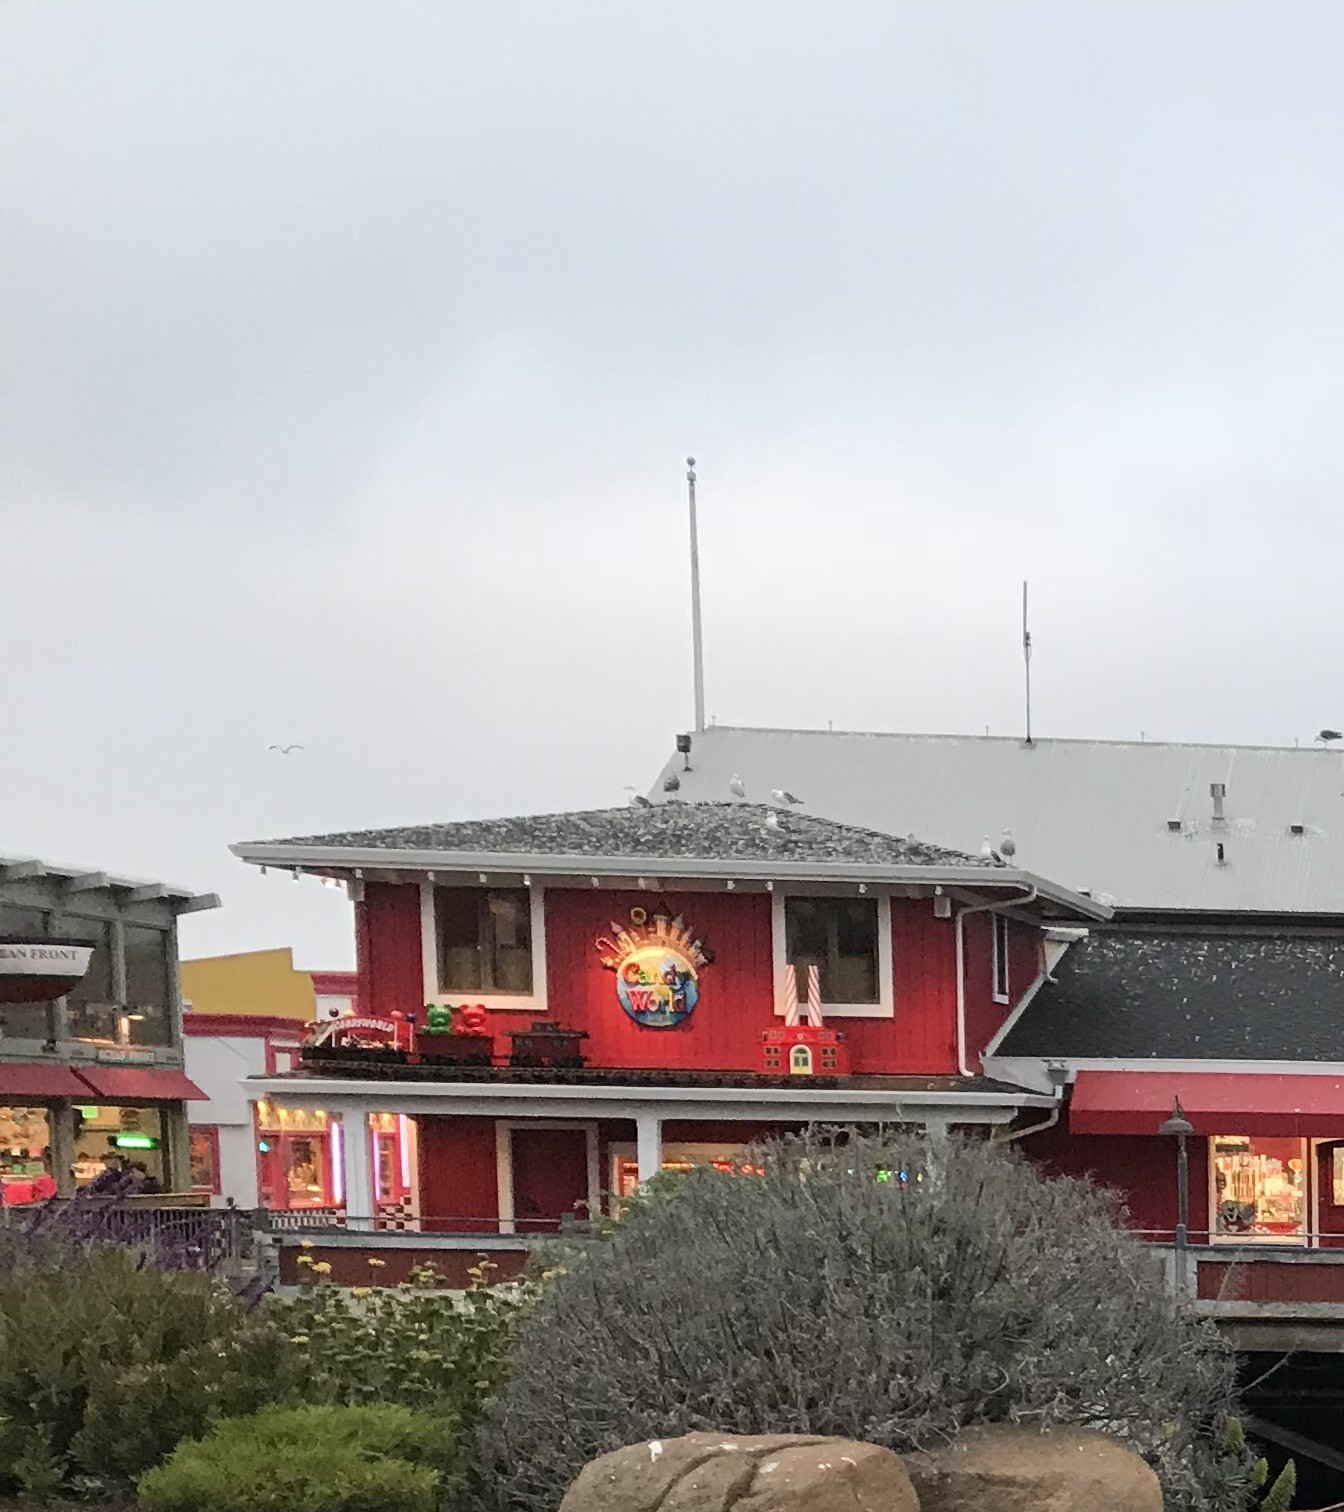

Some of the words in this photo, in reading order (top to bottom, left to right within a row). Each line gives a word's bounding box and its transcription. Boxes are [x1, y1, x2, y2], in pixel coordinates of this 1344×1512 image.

[30, 949, 79, 961] FRONT
[622, 962, 690, 990] Candy
[626, 988, 687, 1014] World
